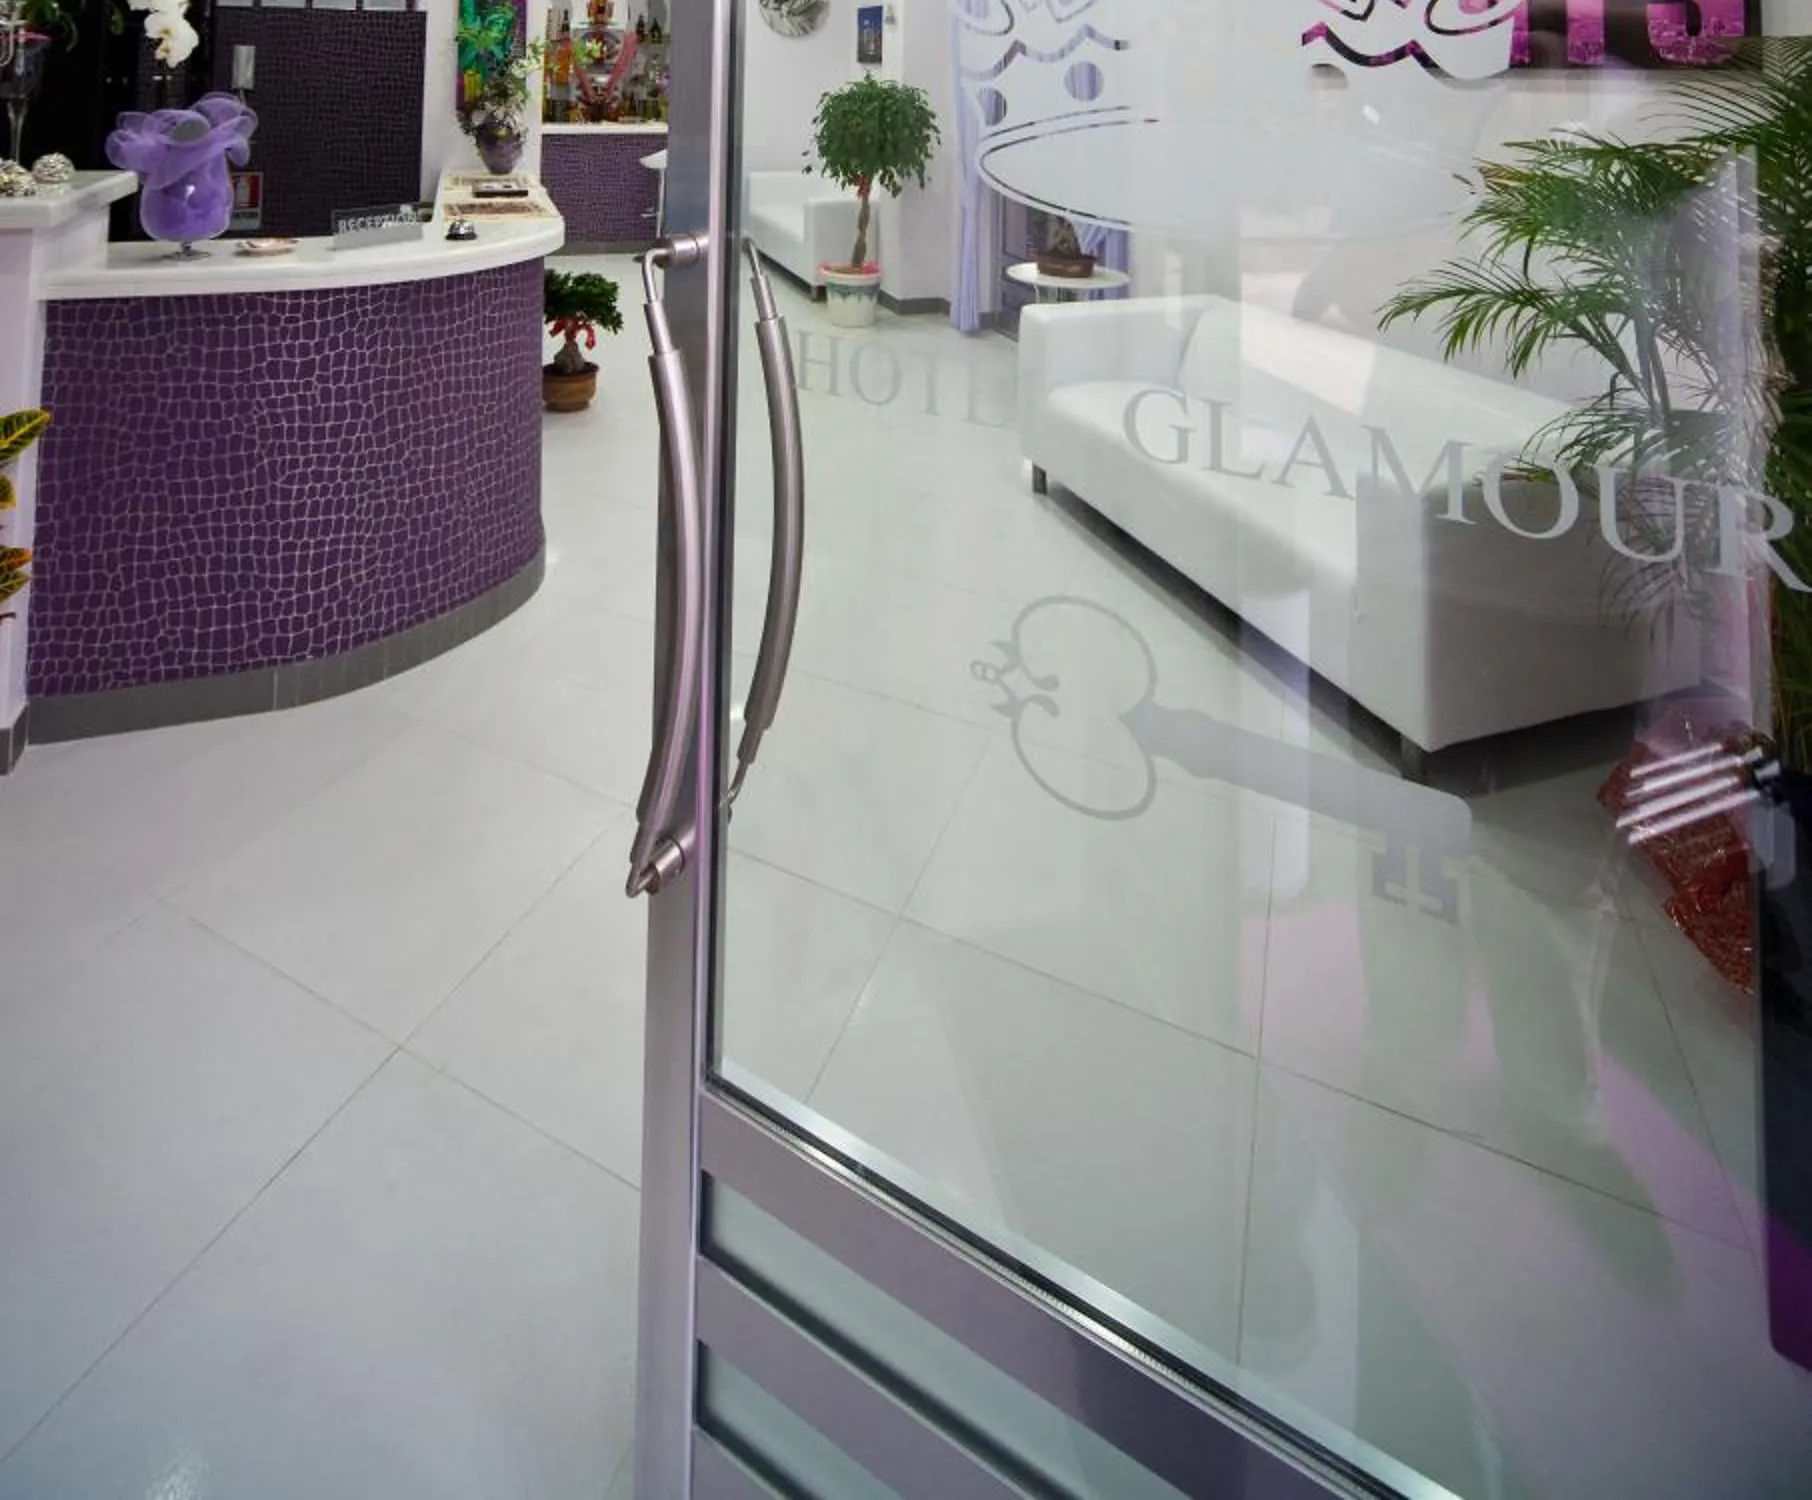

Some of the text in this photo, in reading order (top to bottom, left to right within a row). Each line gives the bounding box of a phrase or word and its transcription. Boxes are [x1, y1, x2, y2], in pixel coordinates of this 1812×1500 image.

[337, 209, 417, 233] RECEPTION
[795, 329, 1812, 593] HOTE GLAMOUR
